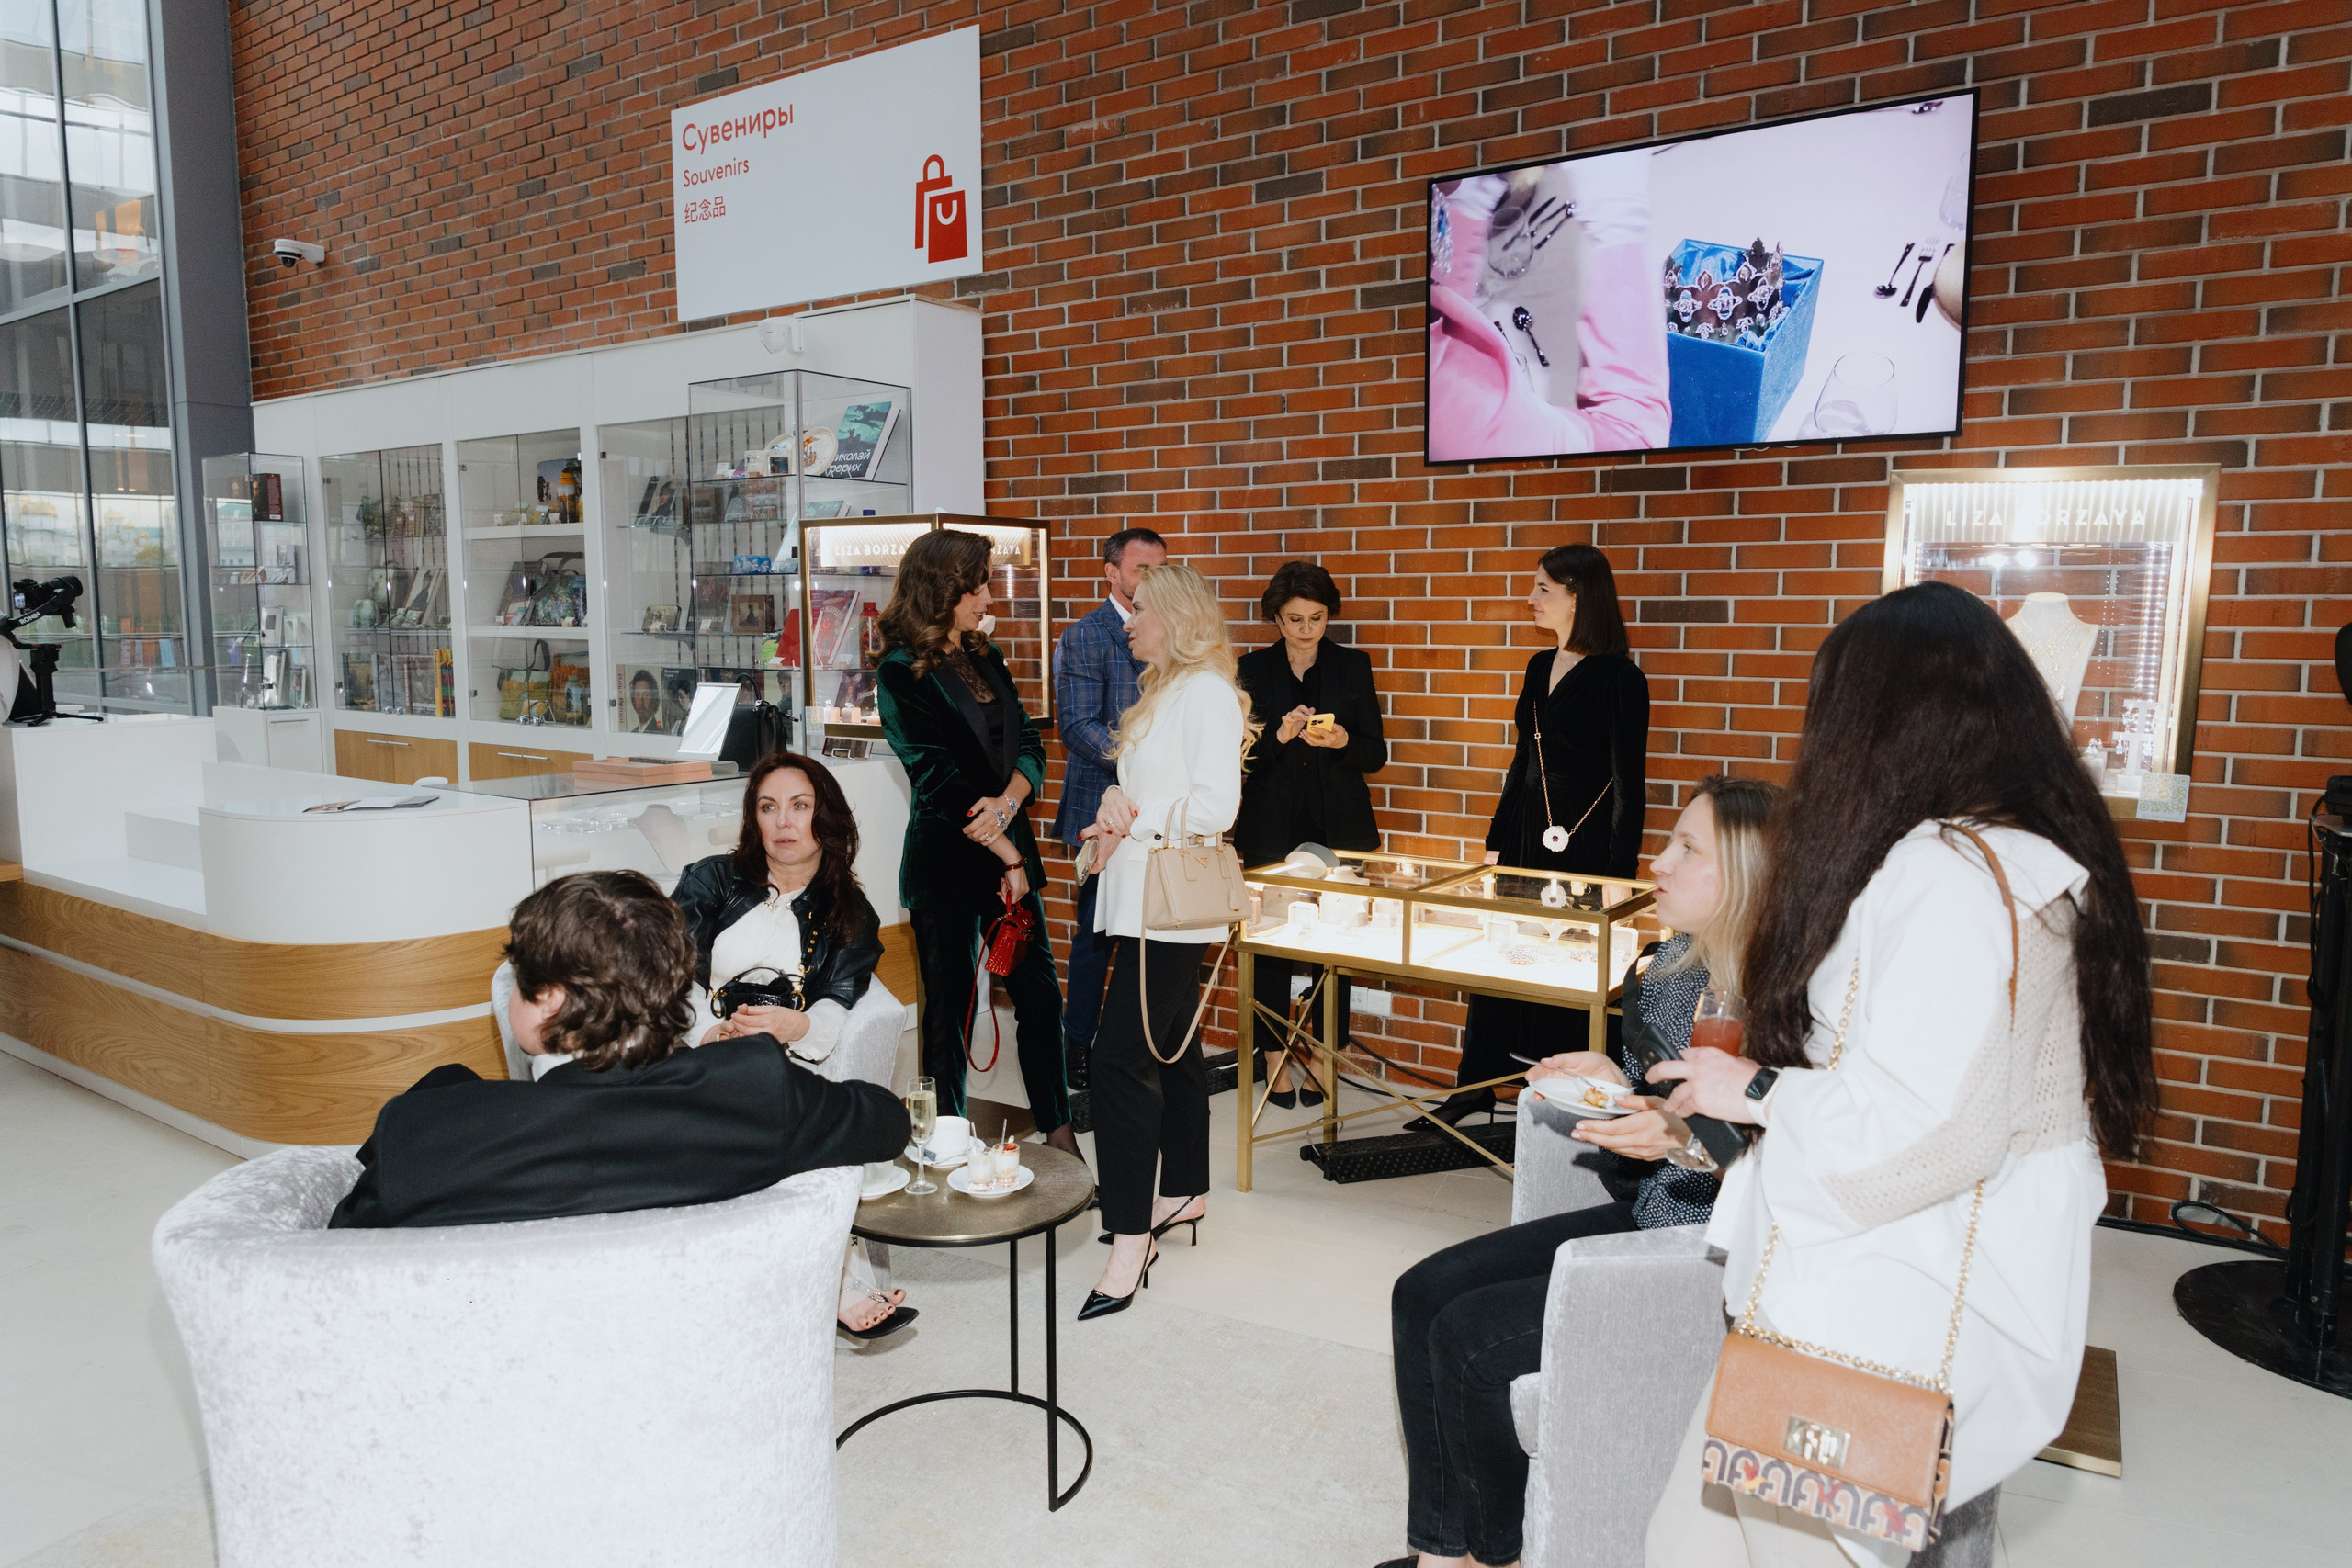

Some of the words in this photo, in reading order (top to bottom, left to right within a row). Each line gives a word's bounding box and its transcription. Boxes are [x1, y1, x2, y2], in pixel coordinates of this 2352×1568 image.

[683, 103, 794, 155] Сувениры
[683, 157, 750, 188] Souvenirs
[684, 195, 727, 224] 纪念品
[834, 448, 872, 462] иколай
[1945, 509, 2004, 527] LIZA
[2015, 508, 2146, 527] ORZAYA
[834, 544, 862, 557] LIZA
[864, 543, 910, 556] BORZA
[18, 611, 41, 625] RONIN
